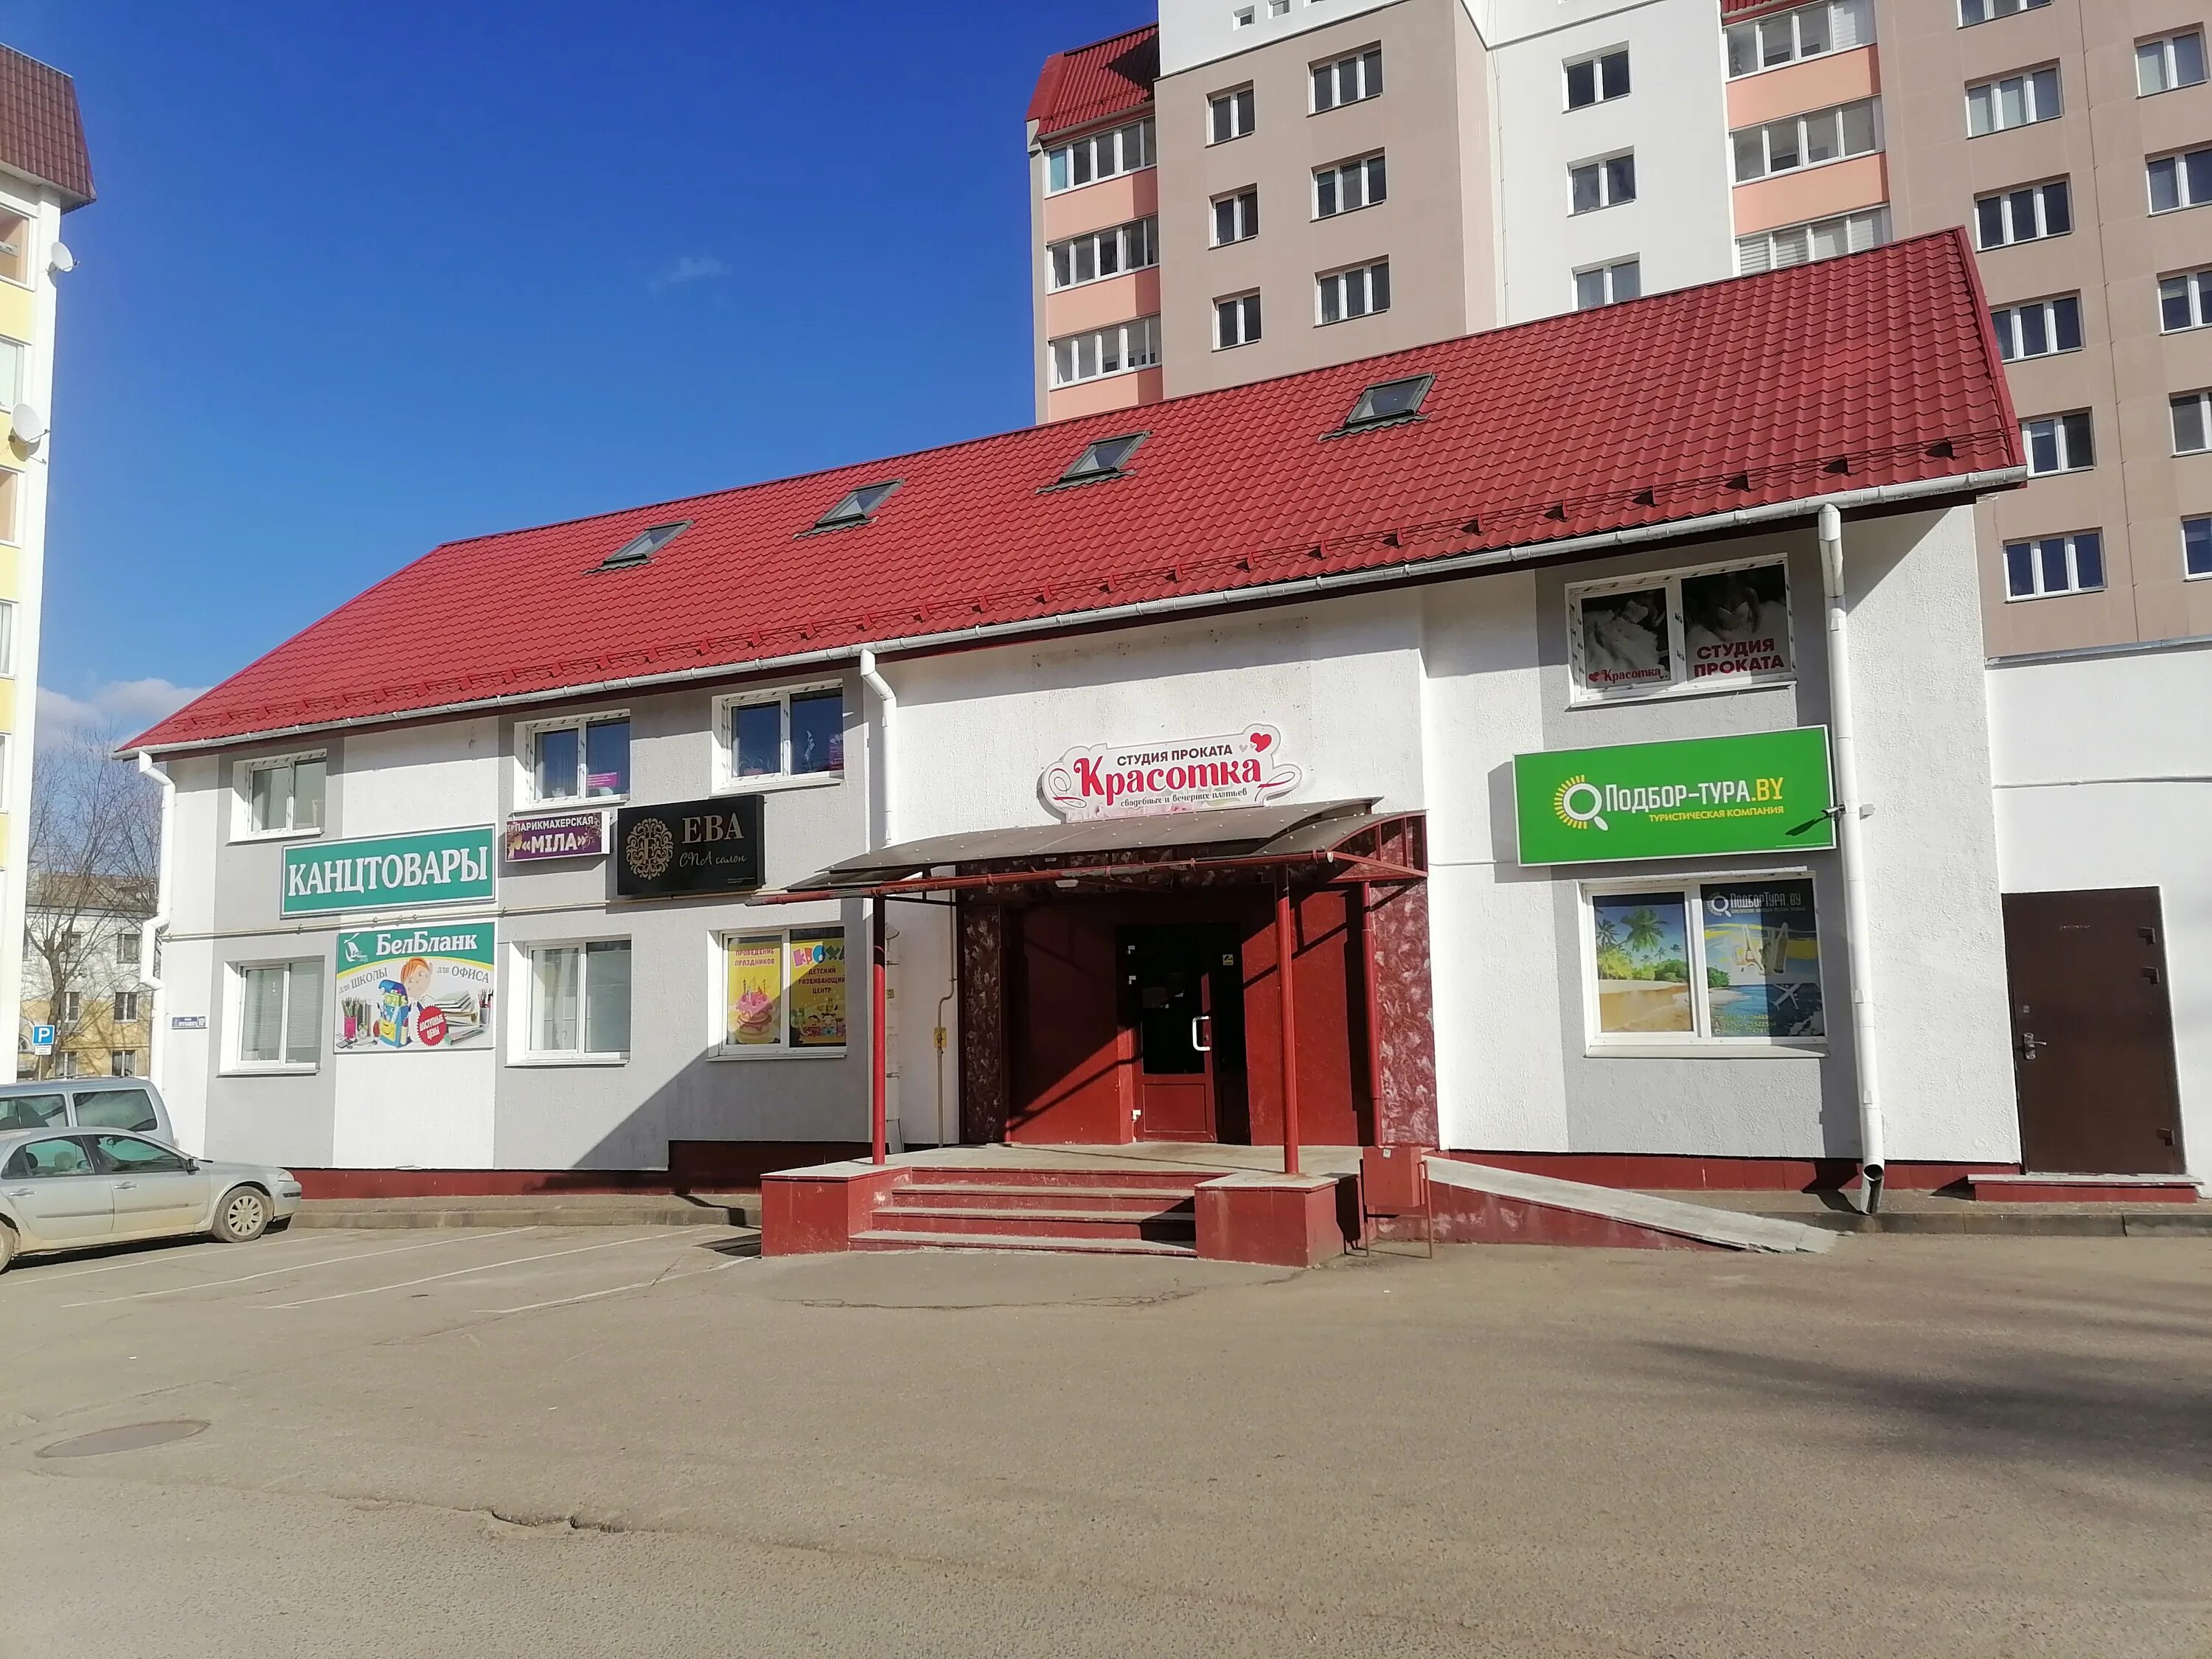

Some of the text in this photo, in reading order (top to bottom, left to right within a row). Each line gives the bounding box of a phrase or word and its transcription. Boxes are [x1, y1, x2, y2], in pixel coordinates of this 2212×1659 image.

[1697, 639, 1775, 659] СТУДИЯ
[1694, 655, 1784, 677] ПРОКАТА
[1601, 667, 1661, 684] Красотка
[1117, 745, 1233, 767] СТУДИЯ ПРОКАТА
[1074, 756, 1262, 806] Красотка
[1121, 797, 1162, 808] свадебных
[1172, 793, 1209, 803] вечерних
[1212, 787, 1247, 799] платьев
[1649, 806, 1784, 822] ТУРИСТИЧЕСКАЯ КОМПАНИЯ
[515, 815, 594, 832] ПАРИКМАХЕРСКАЯ
[681, 813, 745, 844] ЕВА
[715, 855, 748, 864] салон
[288, 846, 488, 896] КАНЦТОВАРЫ
[376, 931, 478, 956] БелБланк
[735, 947, 774, 956] ПРОВЕДЕНИЕ
[734, 959, 775, 967] ПРАЗДНИКОВ
[808, 966, 836, 975] ДЕТСКИЙ
[351, 967, 388, 989] ШКОЛЫ
[451, 966, 489, 983] ОФИСА
[38, 1027, 50, 1043] P
